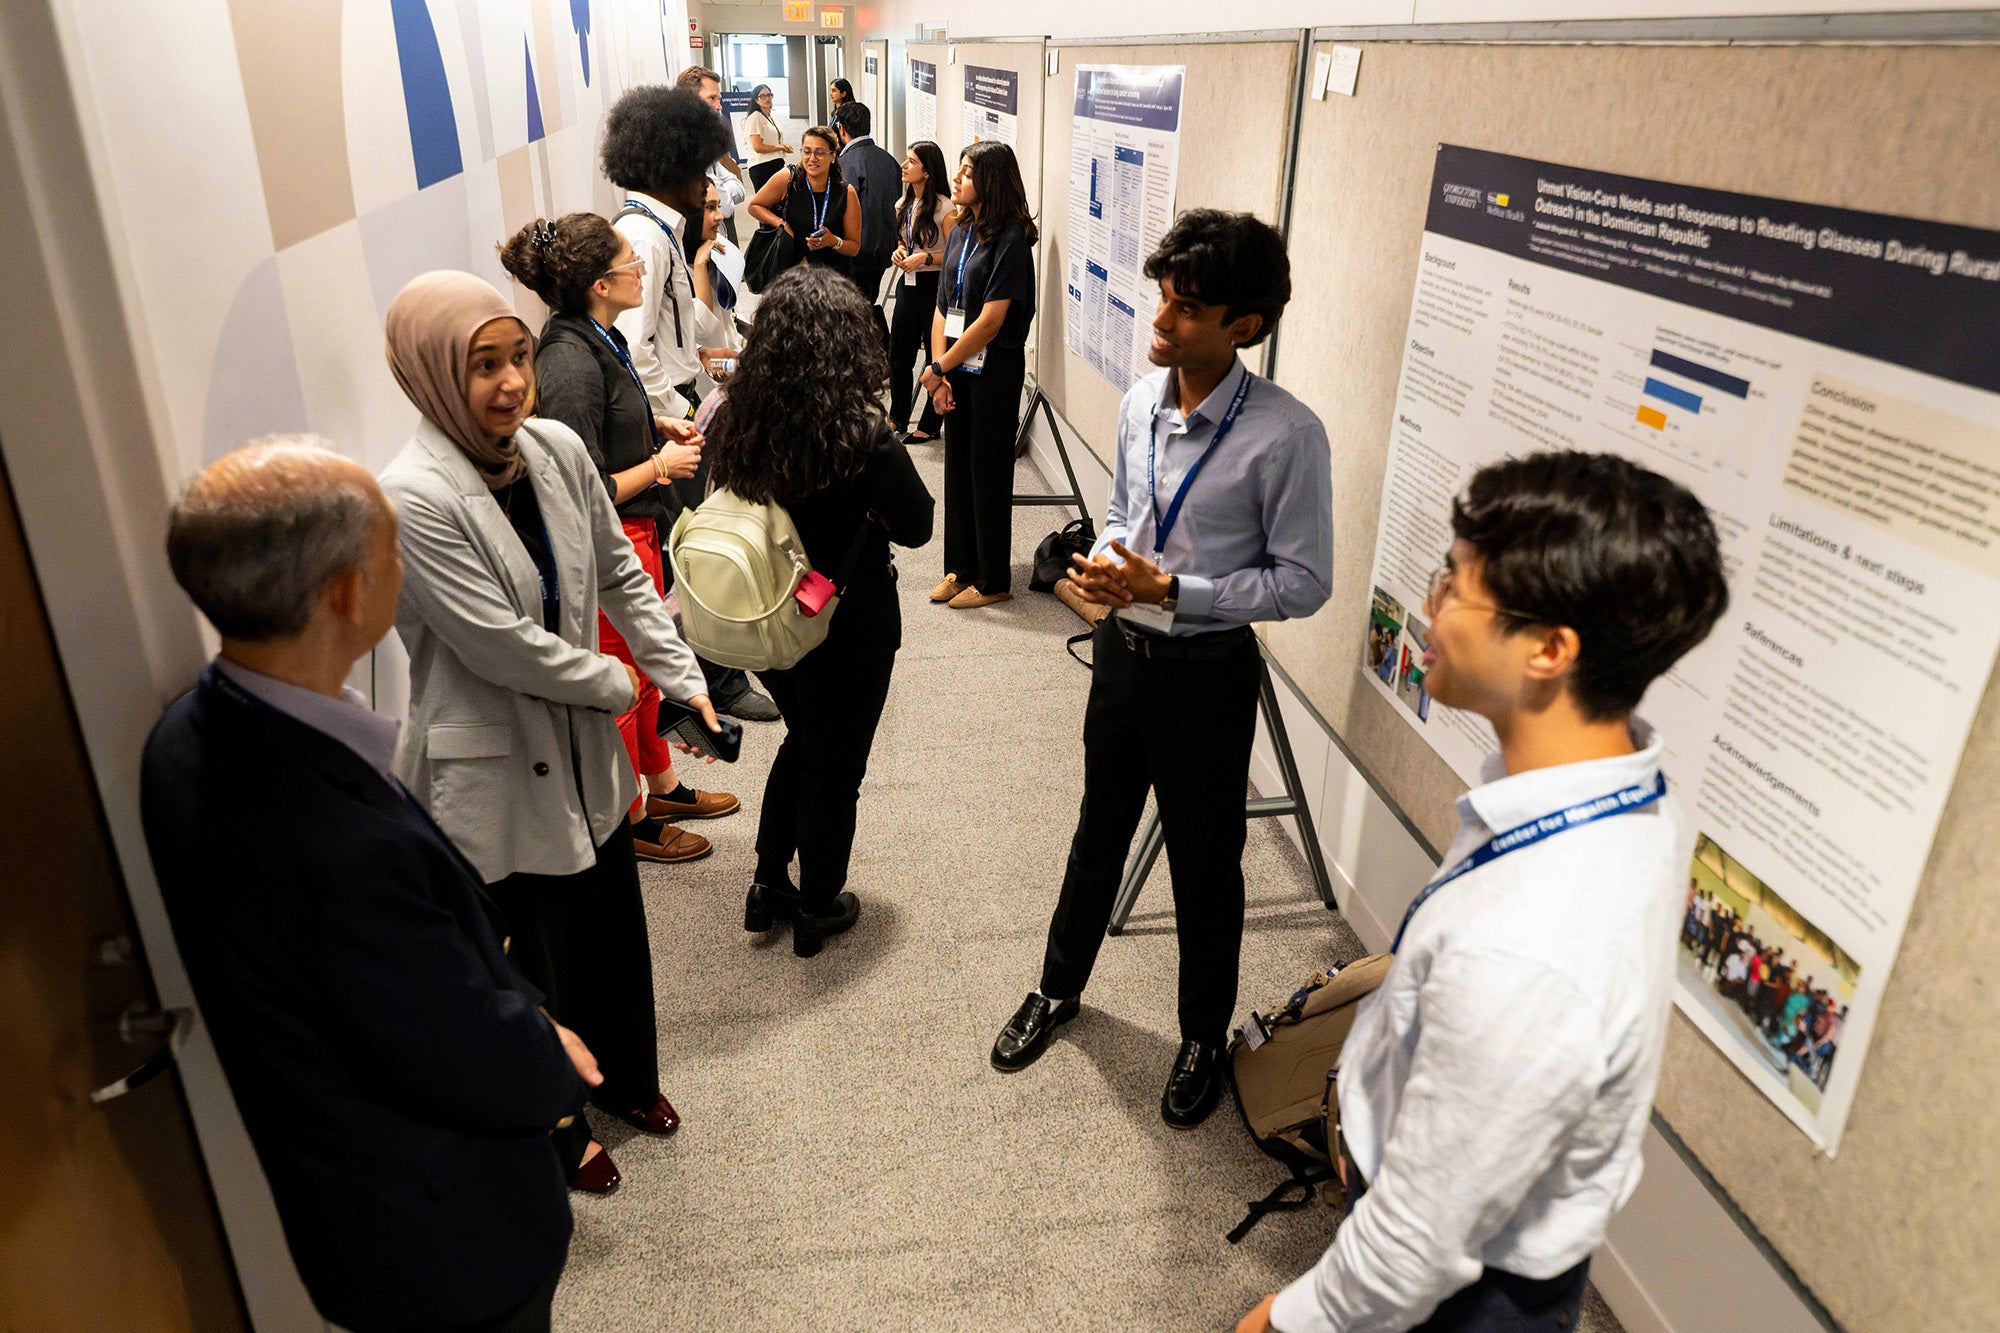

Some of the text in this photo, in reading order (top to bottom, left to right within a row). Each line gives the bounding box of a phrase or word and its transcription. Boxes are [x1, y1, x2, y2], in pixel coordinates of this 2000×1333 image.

[787, 1, 810, 20] EXIT
[824, 12, 841, 27] EXIT
[1535, 198, 1574, 221] Outreach
[1575, 204, 1584, 221] in
[1585, 206, 1601, 226] the
[1602, 211, 1657, 237] Dominican
[1658, 223, 1711, 249] Republic
[1537, 178, 1564, 197] Unmet
[1565, 182, 1617, 208] Vision-Care
[1619, 196, 1652, 216] Needs
[1654, 201, 1675, 219] and
[1677, 204, 1739, 232] Response
[1740, 215, 1756, 234] to
[1757, 217, 1817, 250] Reading
[1817, 227, 1883, 259] Glasses
[1884, 239, 1948, 275] During
[1424, 251, 1457, 271] Background
[1508, 278, 1531, 296] Results
[1810, 380, 1877, 413] Conclusion
[1400, 414, 1422, 433] Methods
[1768, 512, 1838, 555] Limitations
[1839, 545, 1852, 561] &
[1742, 622, 1804, 668] References
[1491, 825, 1538, 852] Center
[1538, 814, 1564, 832] for
[1563, 796, 1620, 823] Health
